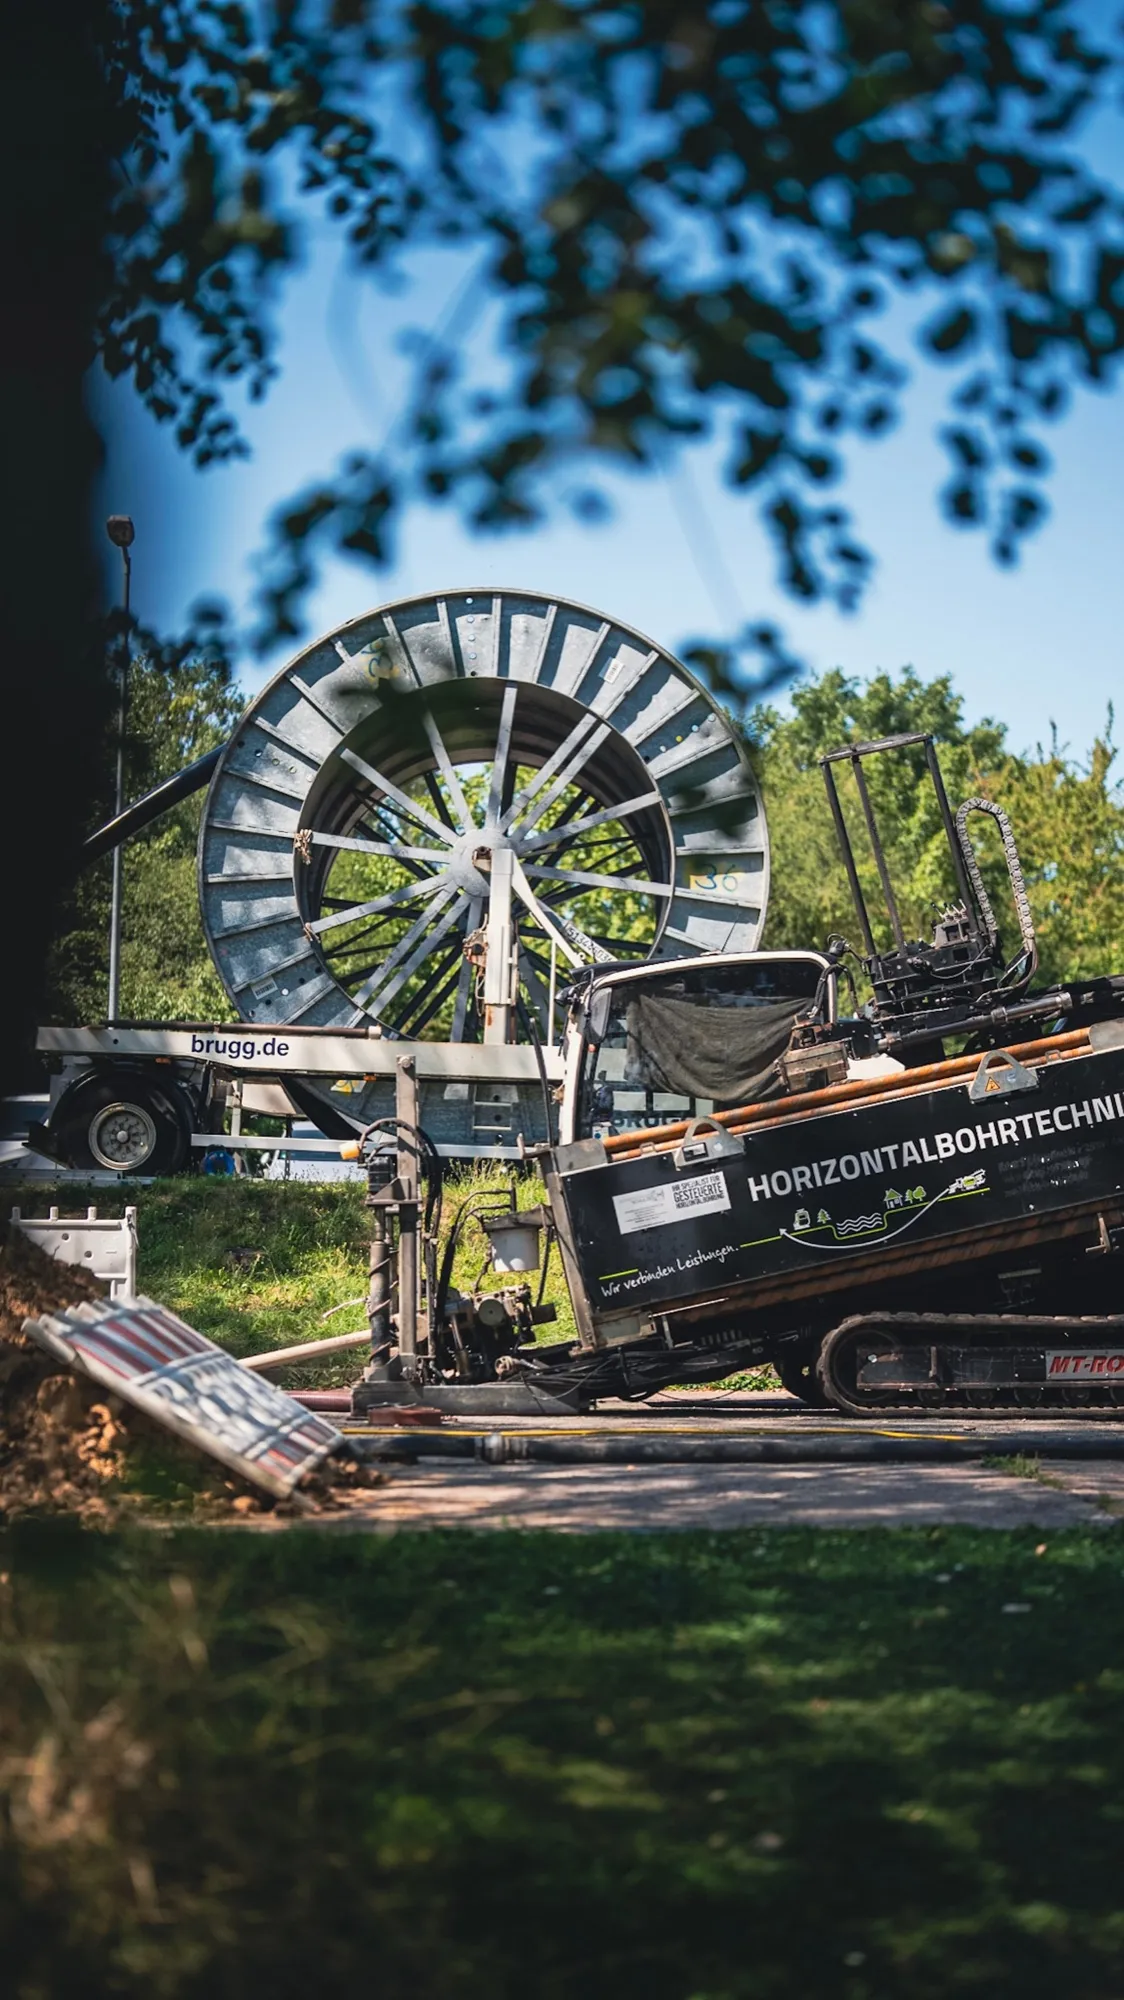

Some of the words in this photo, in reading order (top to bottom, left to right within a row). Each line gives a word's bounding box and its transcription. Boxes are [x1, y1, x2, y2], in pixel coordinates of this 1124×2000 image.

[695, 863, 739, 892] 36
[191, 1034, 290, 1060] brugg.de
[748, 1092, 1124, 1202] HORIZONTALBOHRTECHNI
[673, 1182, 724, 1203] GESTEUERTE
[682, 1177, 709, 1190] SPEZIALIST
[601, 1282, 621, 1298] Wir
[623, 1265, 676, 1291] verbinden
